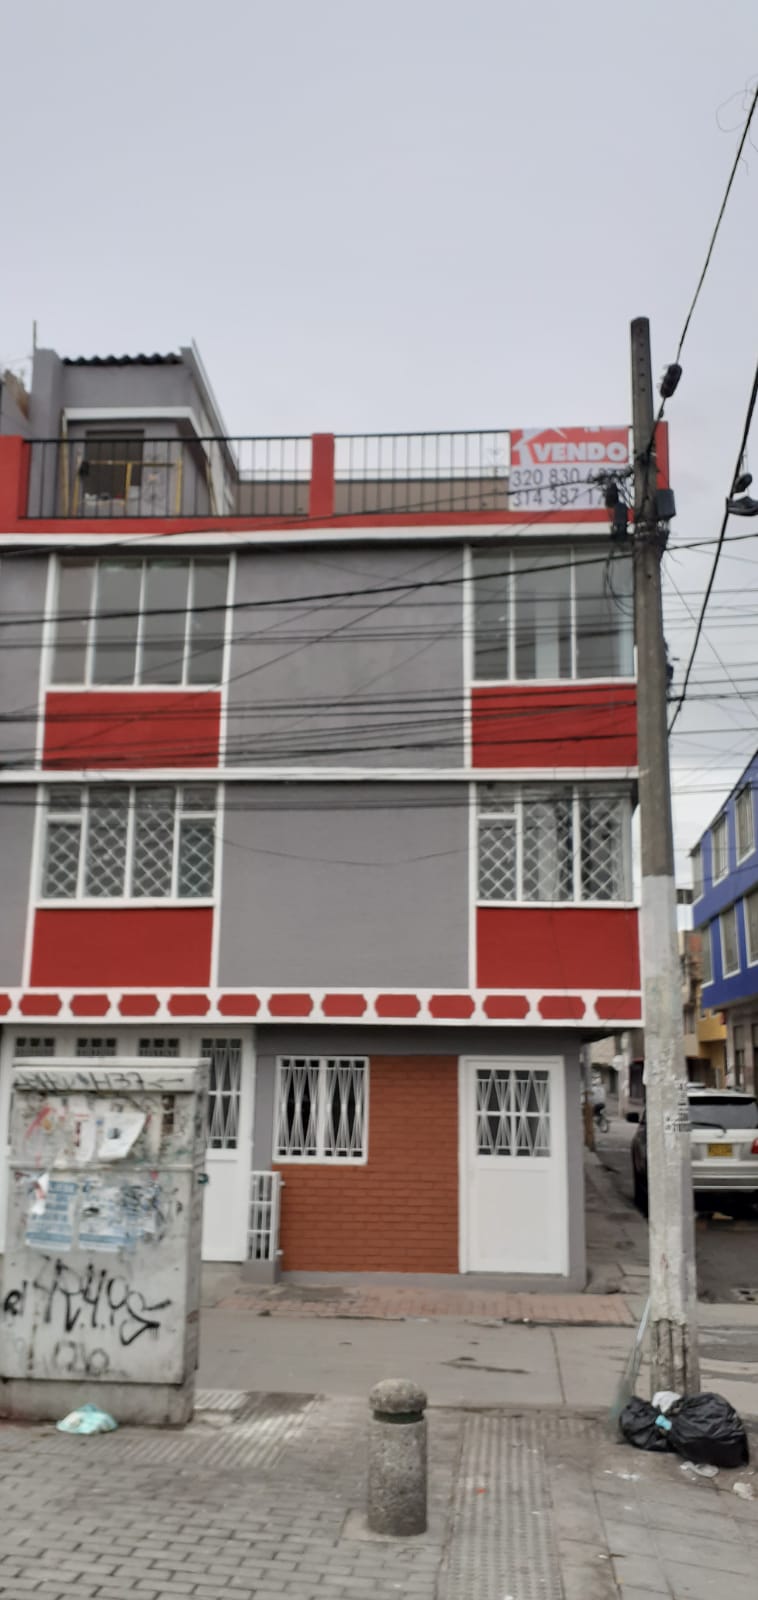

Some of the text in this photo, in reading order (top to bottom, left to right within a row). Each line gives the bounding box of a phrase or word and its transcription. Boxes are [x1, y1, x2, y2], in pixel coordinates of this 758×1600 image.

[532, 442, 627, 462] VENDO
[512, 468, 543, 487] 320
[549, 467, 580, 486] 830
[512, 488, 543, 507] 314
[550, 487, 579, 506] 387
